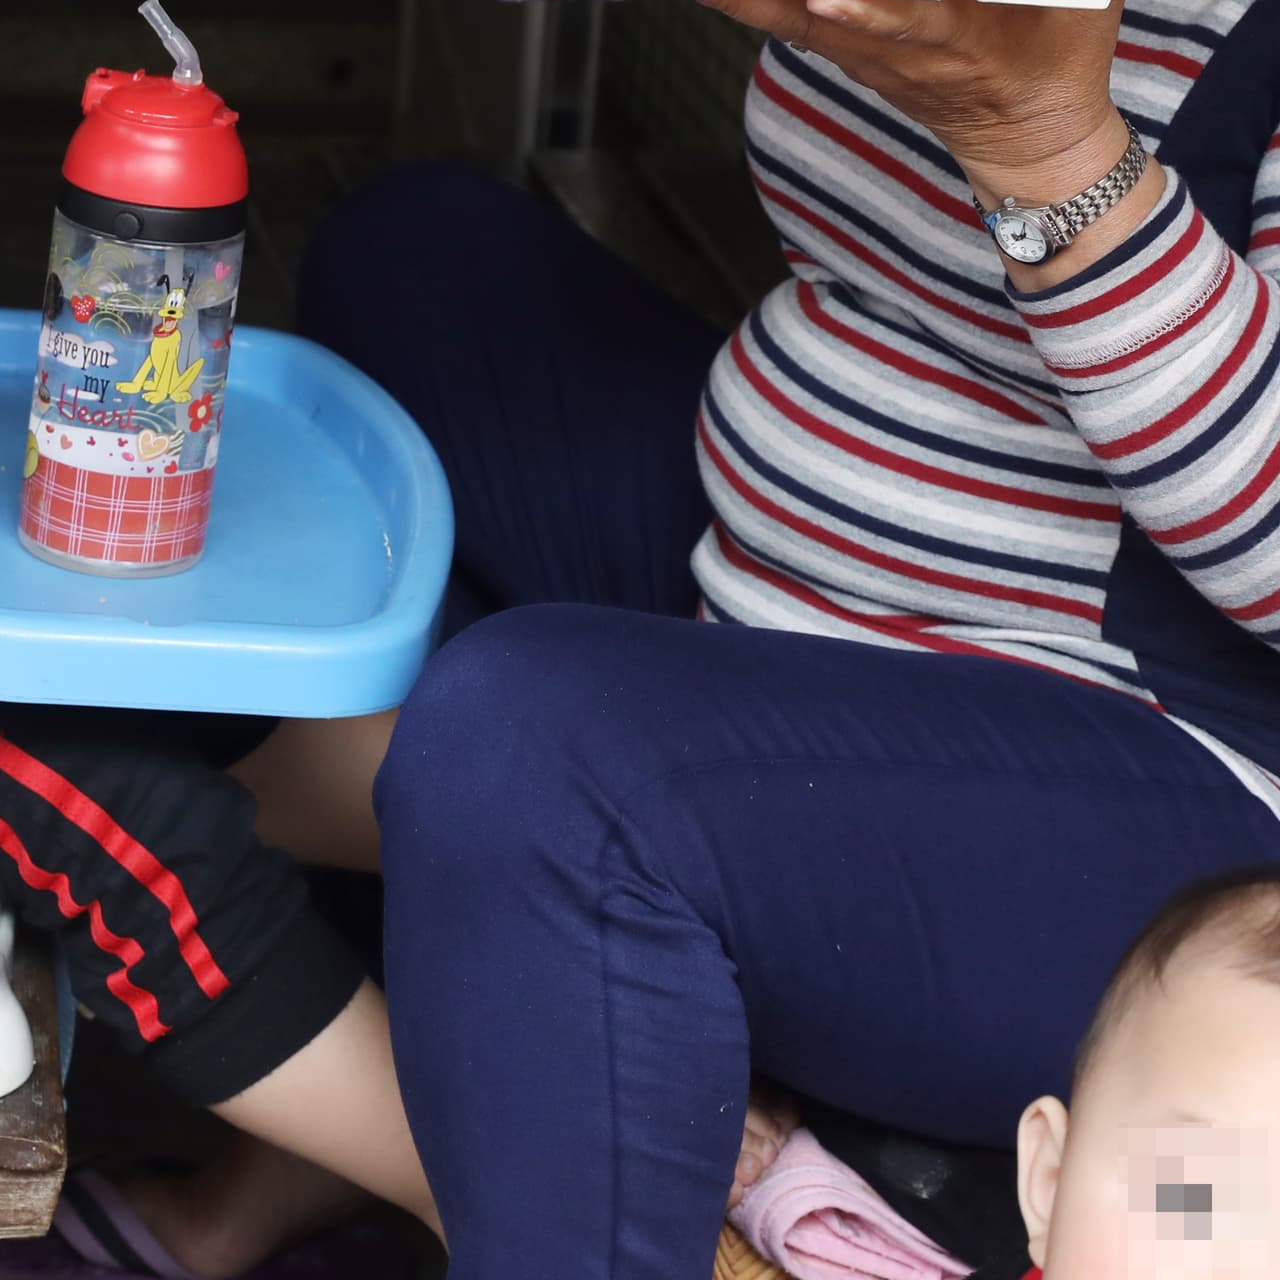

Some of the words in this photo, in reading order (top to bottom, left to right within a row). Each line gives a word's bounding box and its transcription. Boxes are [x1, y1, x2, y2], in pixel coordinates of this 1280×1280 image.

[53, 332, 77, 360] give
[81, 345, 110, 370] you
[57, 383, 141, 431] Heart
[83, 375, 110, 403] my
